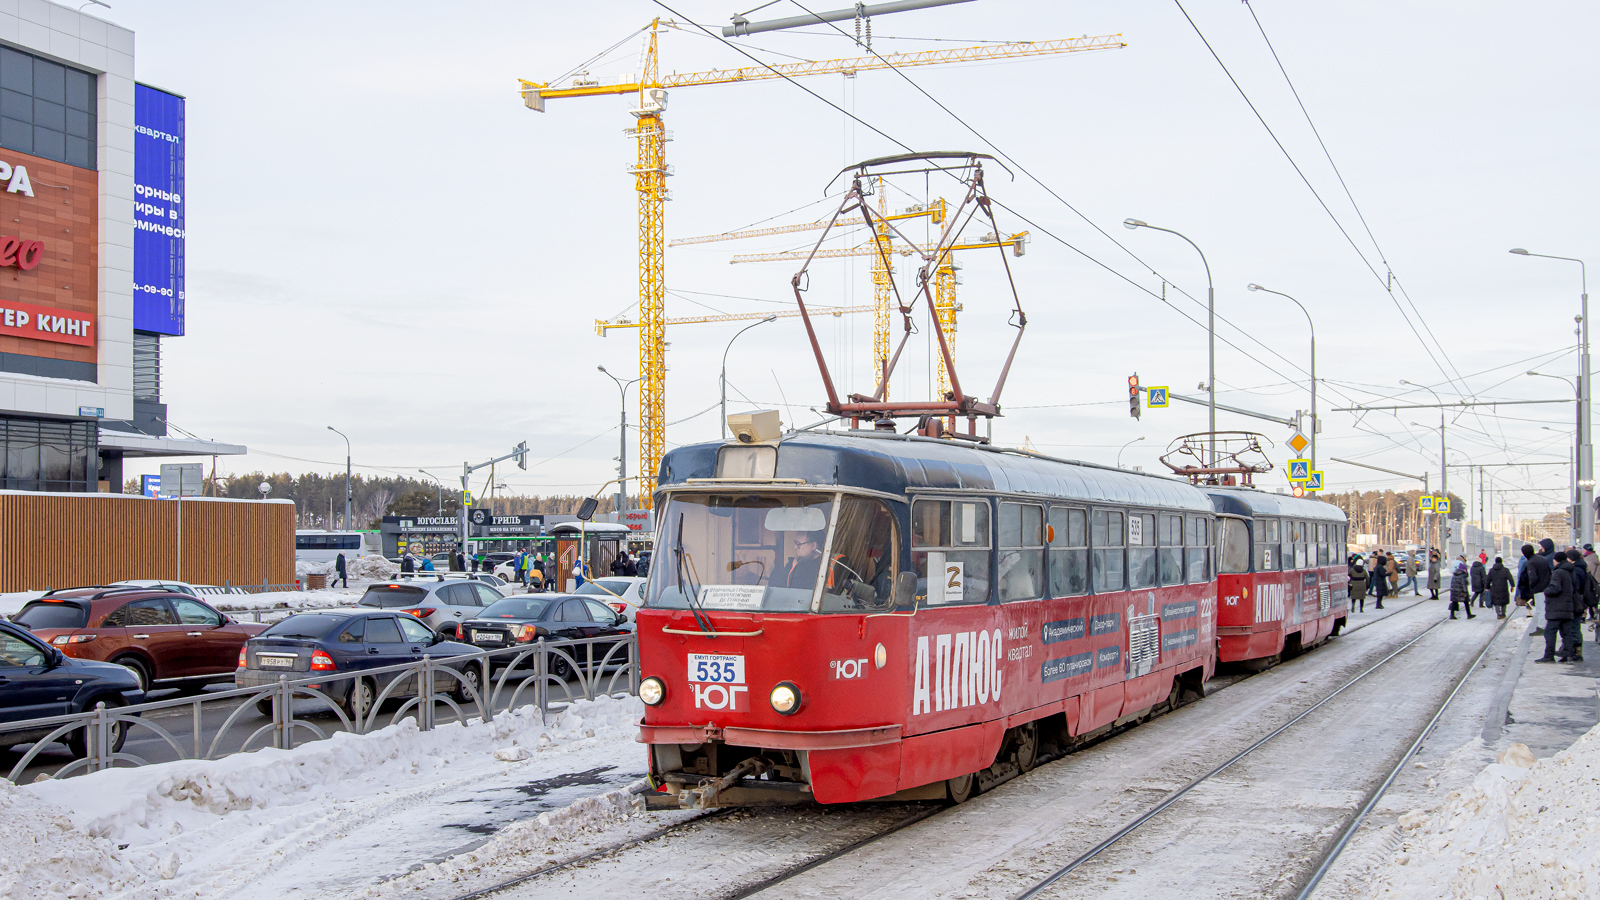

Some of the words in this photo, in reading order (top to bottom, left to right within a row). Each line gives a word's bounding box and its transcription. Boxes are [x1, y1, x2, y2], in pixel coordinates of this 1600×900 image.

[134, 183, 181, 204] орные
[134, 201, 165, 217] иры
[169, 209, 178, 220] в
[36, 313, 91, 337] КИНГ
[491, 515, 521, 525] ГРИЛЬ
[1226, 595, 1240, 606] ЮГ
[1008, 622, 1028, 640] жилой
[1008, 645, 1033, 662] квартал
[697, 661, 736, 682] 535
[836, 658, 869, 679] ЮГ
[1044, 666, 1058, 677] Более
[1059, 662, 1066, 673] 60
[694, 684, 748, 710] ЮГ
